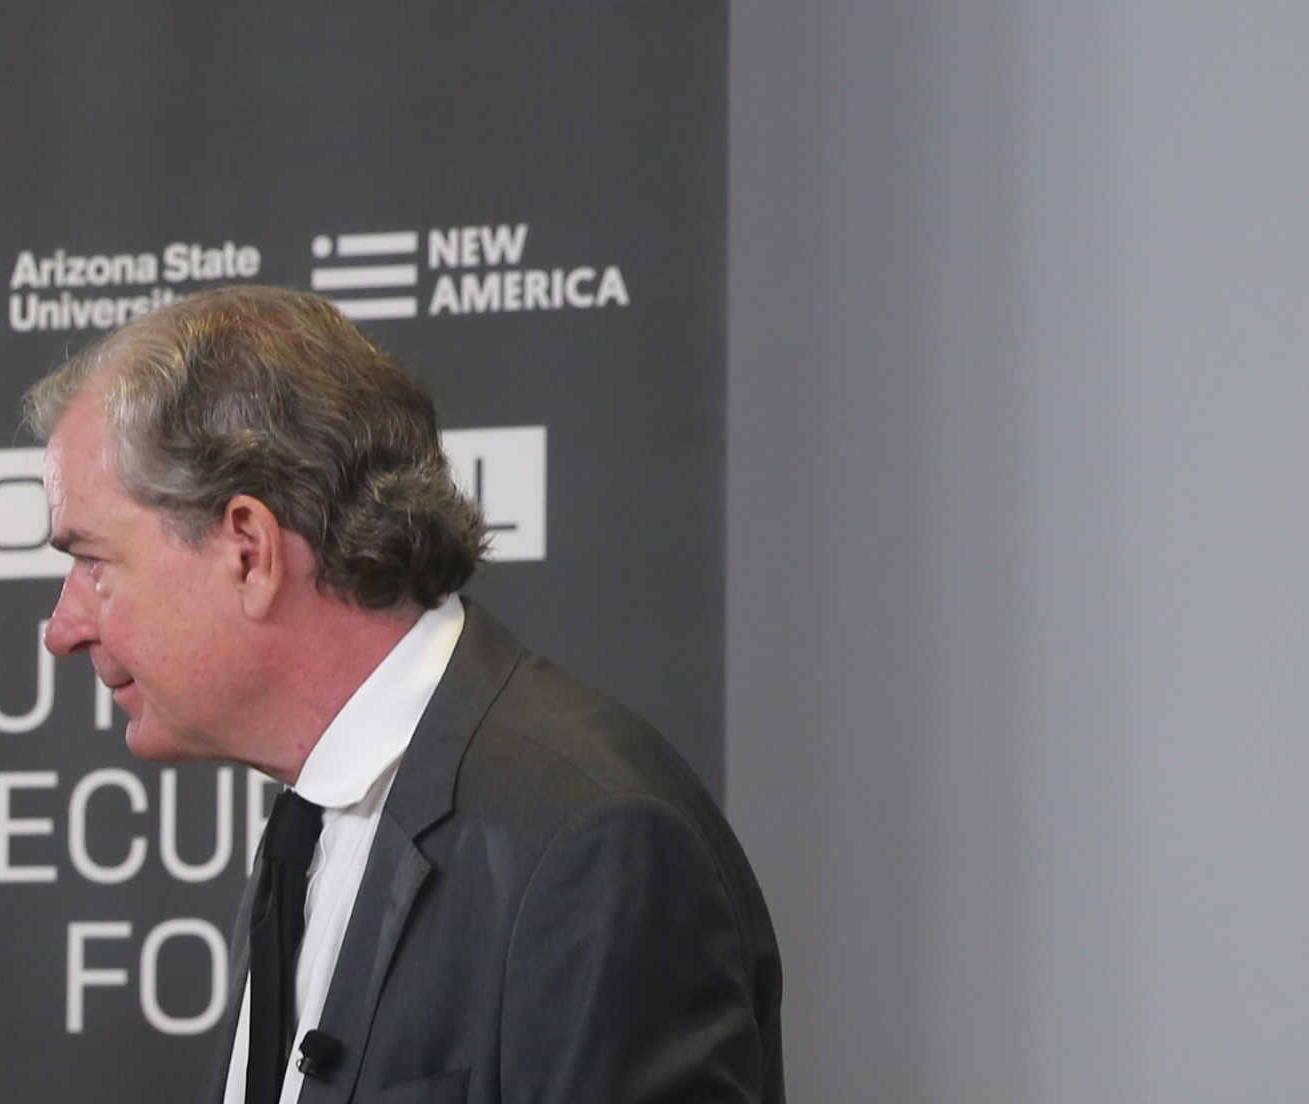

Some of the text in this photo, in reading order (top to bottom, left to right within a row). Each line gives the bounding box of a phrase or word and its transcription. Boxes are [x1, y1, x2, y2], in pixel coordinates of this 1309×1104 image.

[10, 241, 261, 290] Arizona State
[428, 223, 529, 270] NEW
[10, 286, 188, 332] Universit
[428, 264, 631, 316] AMERICA
